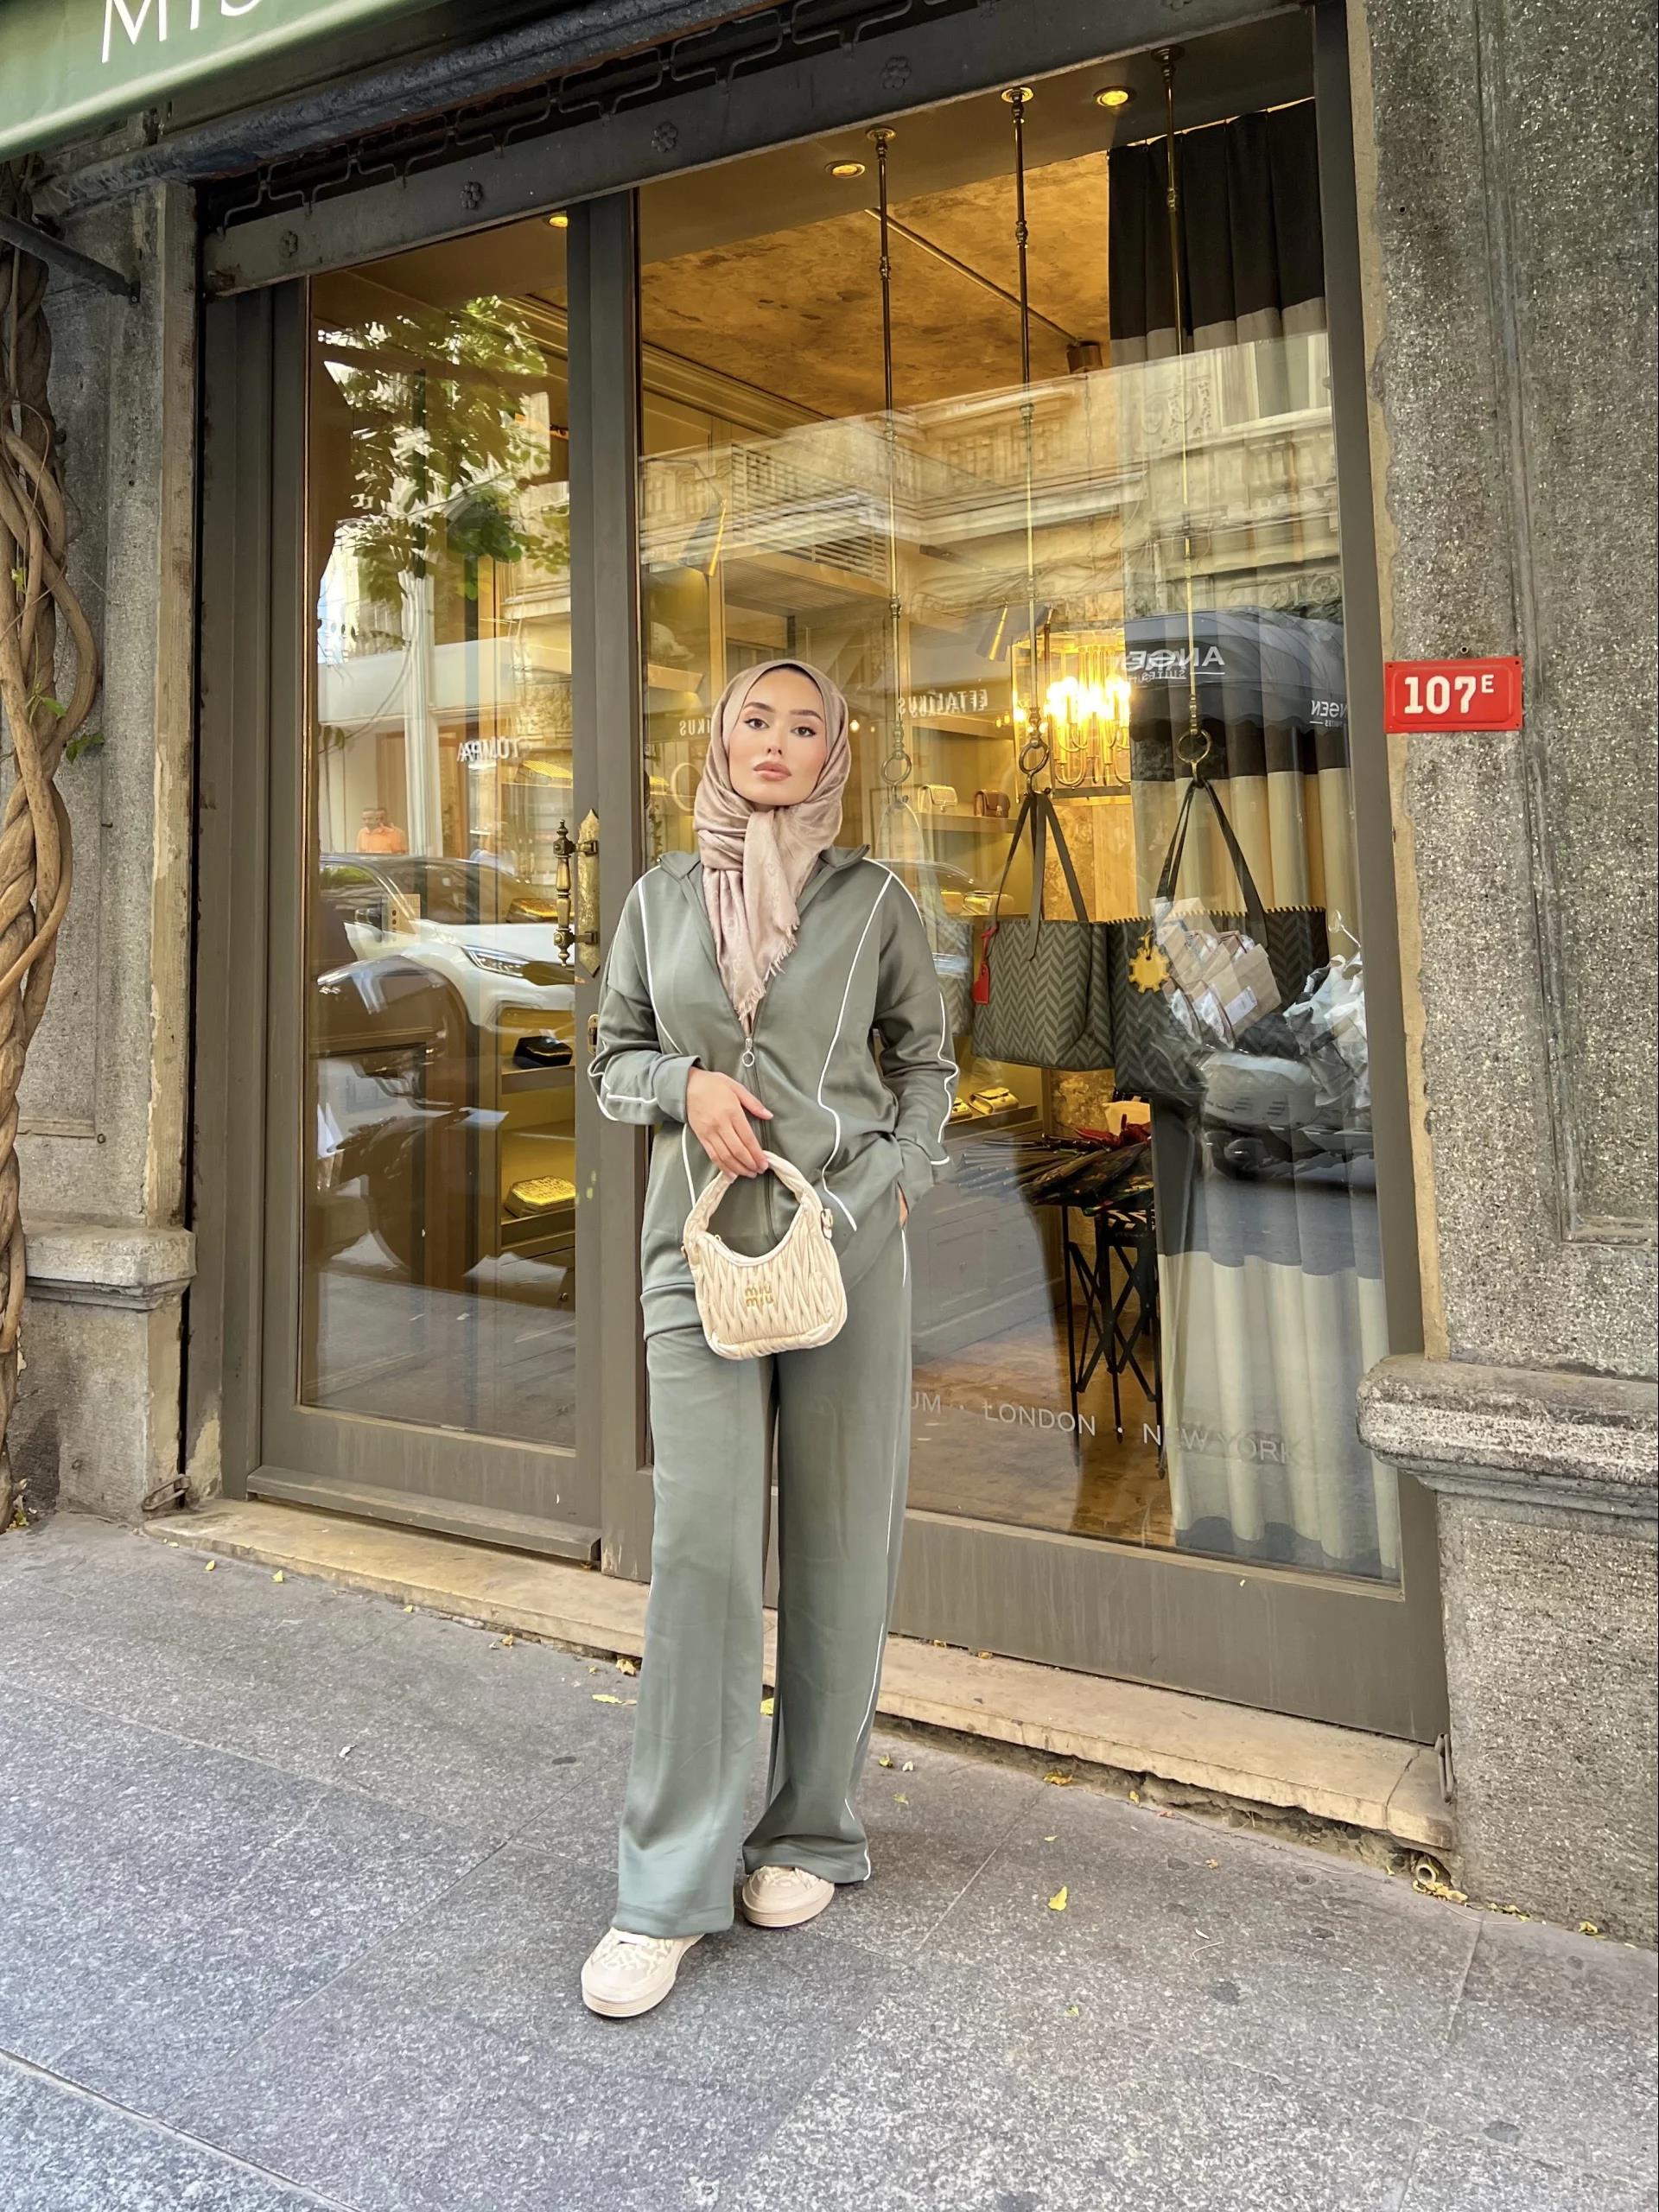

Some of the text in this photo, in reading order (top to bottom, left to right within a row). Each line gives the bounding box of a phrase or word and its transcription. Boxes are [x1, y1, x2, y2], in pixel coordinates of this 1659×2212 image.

[984, 1401, 1096, 1436] LONDON
[1142, 1422, 1208, 1452] NEW
[1217, 1431, 1306, 1465] YORK
